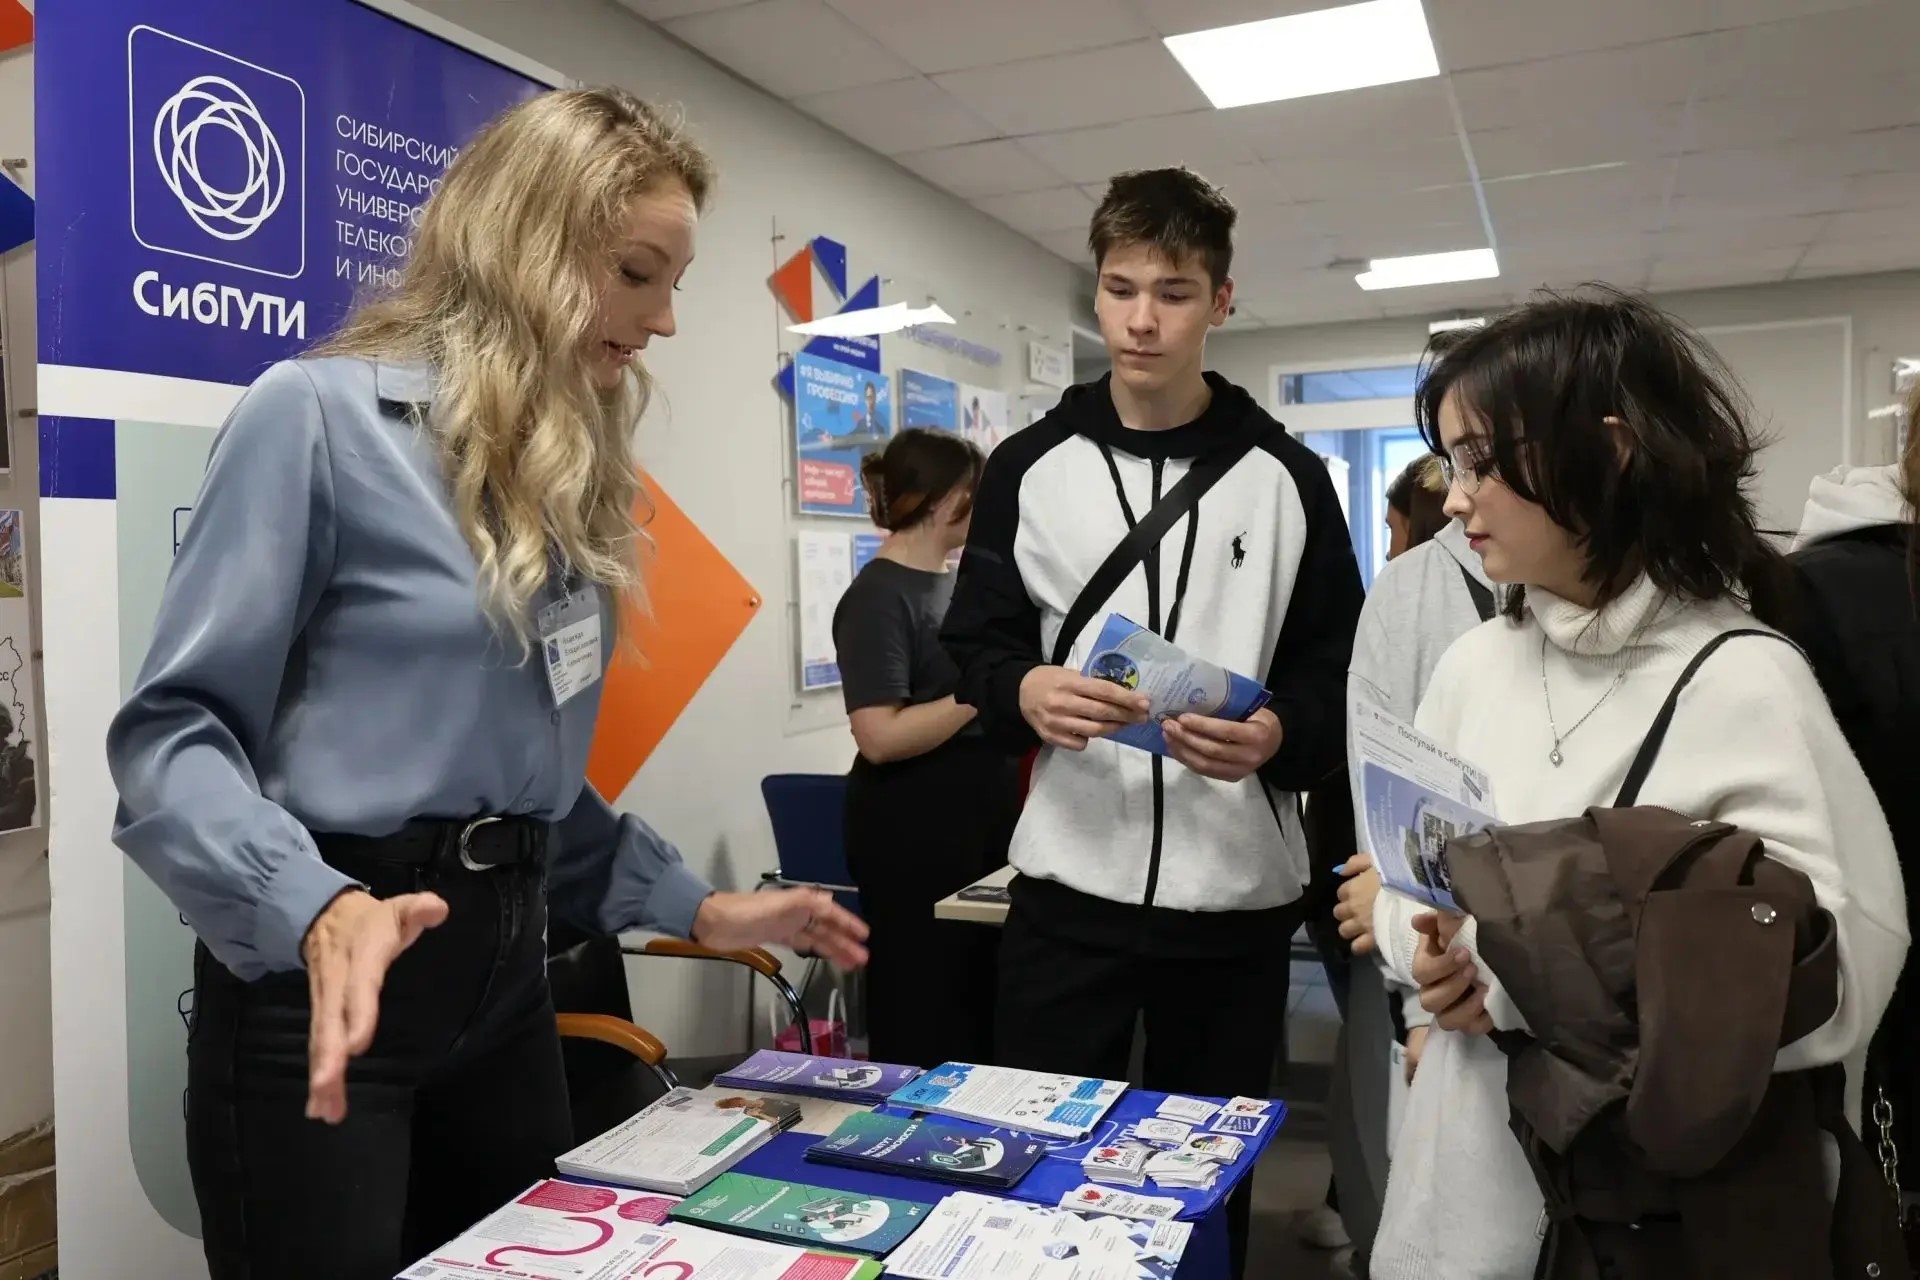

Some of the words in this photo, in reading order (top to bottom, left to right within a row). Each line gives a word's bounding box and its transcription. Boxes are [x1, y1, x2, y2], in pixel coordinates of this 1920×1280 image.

[336, 115, 459, 168] СИБИРСКИЙ
[335, 220, 414, 260] ТЕЛЕКО
[336, 256, 350, 279] И
[358, 261, 405, 289] ИНФ
[133, 270, 305, 340] СибГУТИ
